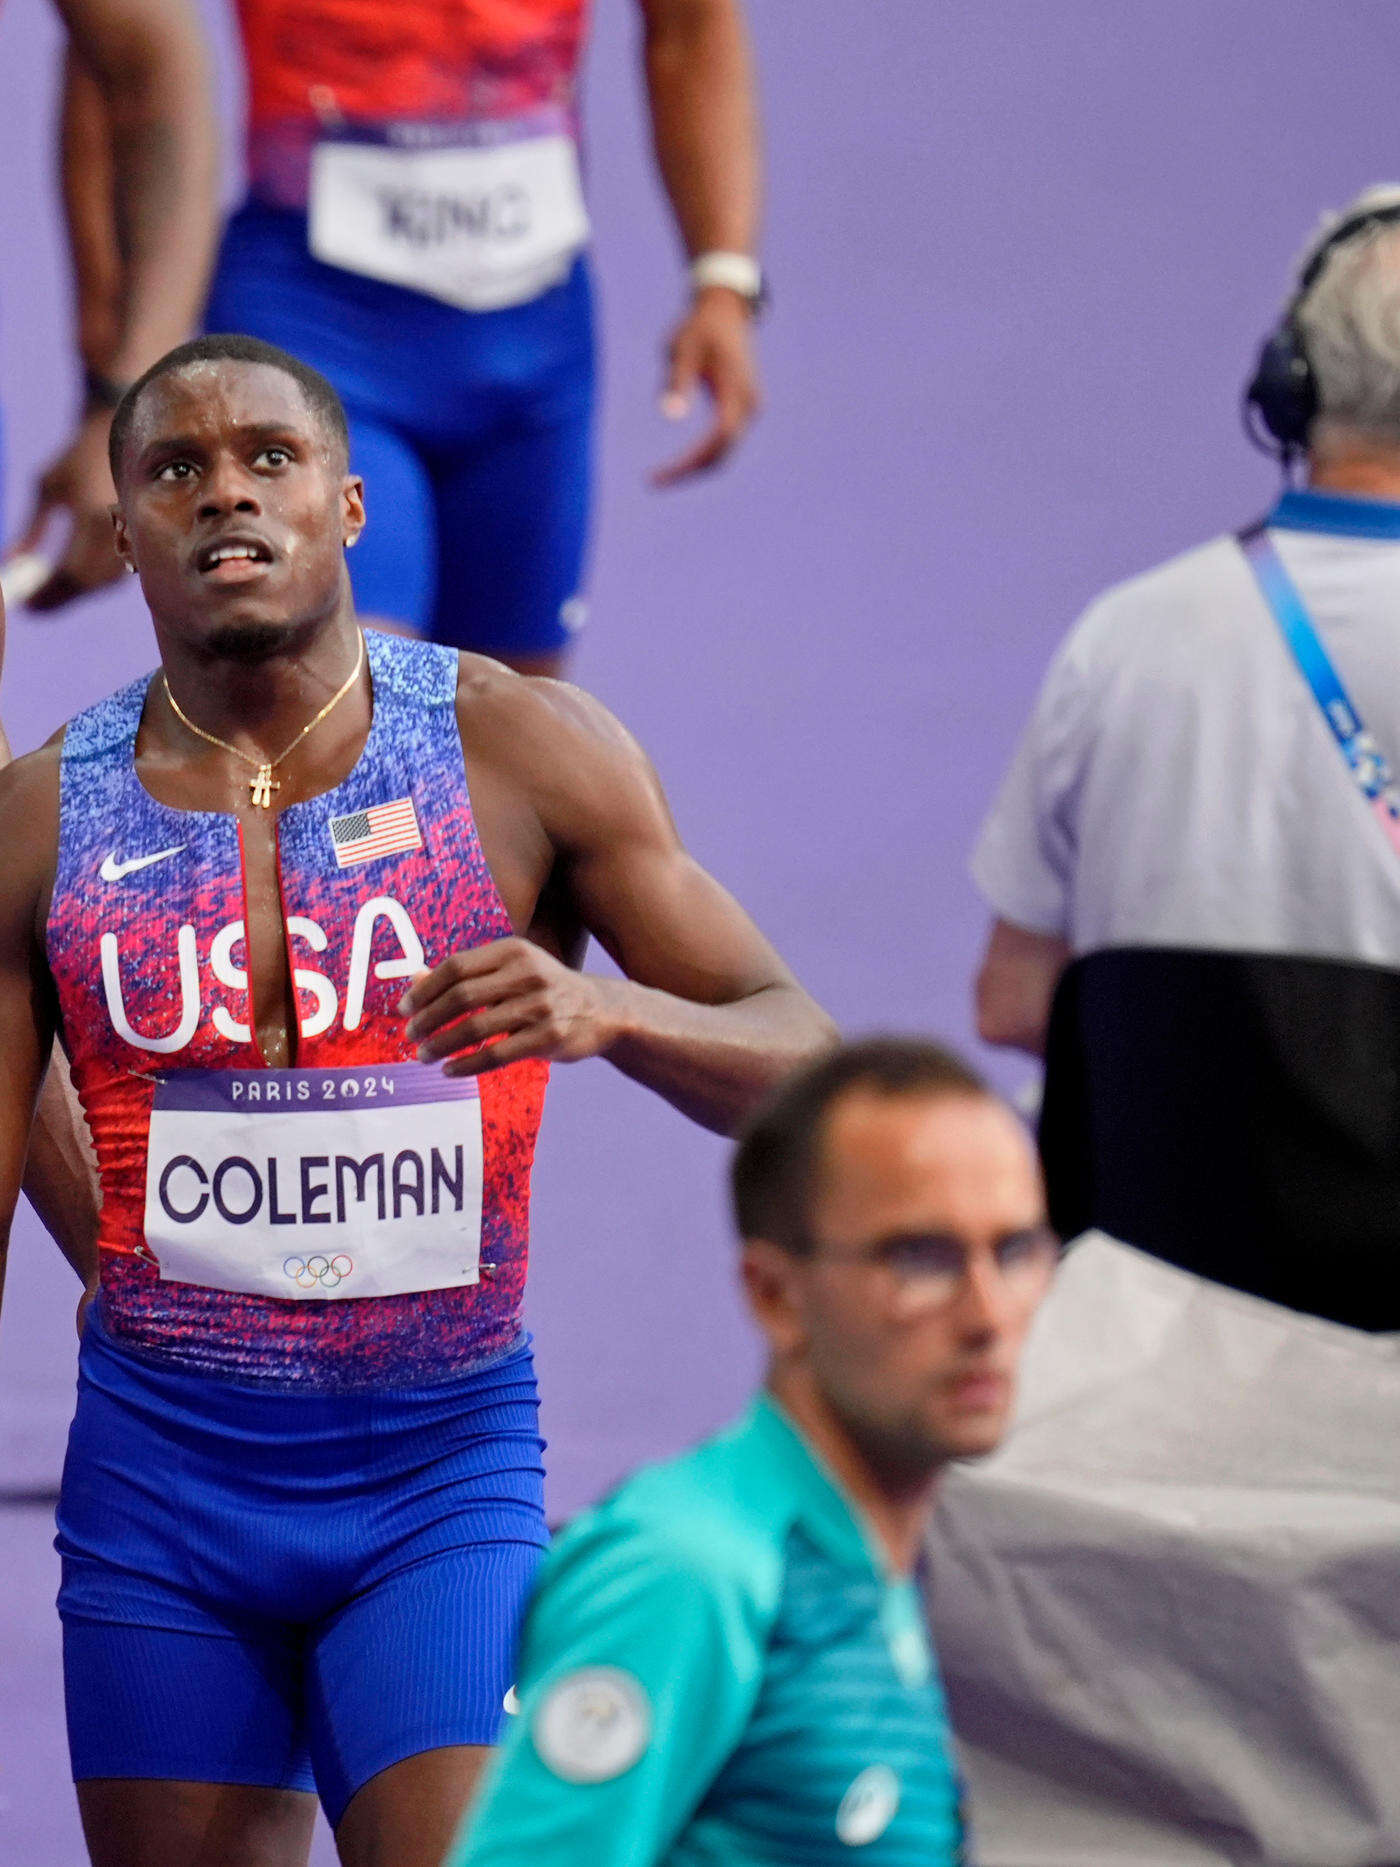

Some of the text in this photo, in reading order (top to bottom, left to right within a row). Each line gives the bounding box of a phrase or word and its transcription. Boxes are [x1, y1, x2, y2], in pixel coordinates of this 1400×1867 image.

[100, 896, 428, 1054] USA
[321, 1076, 396, 1100] 2024
[158, 1144, 464, 1226] COLEMAN
